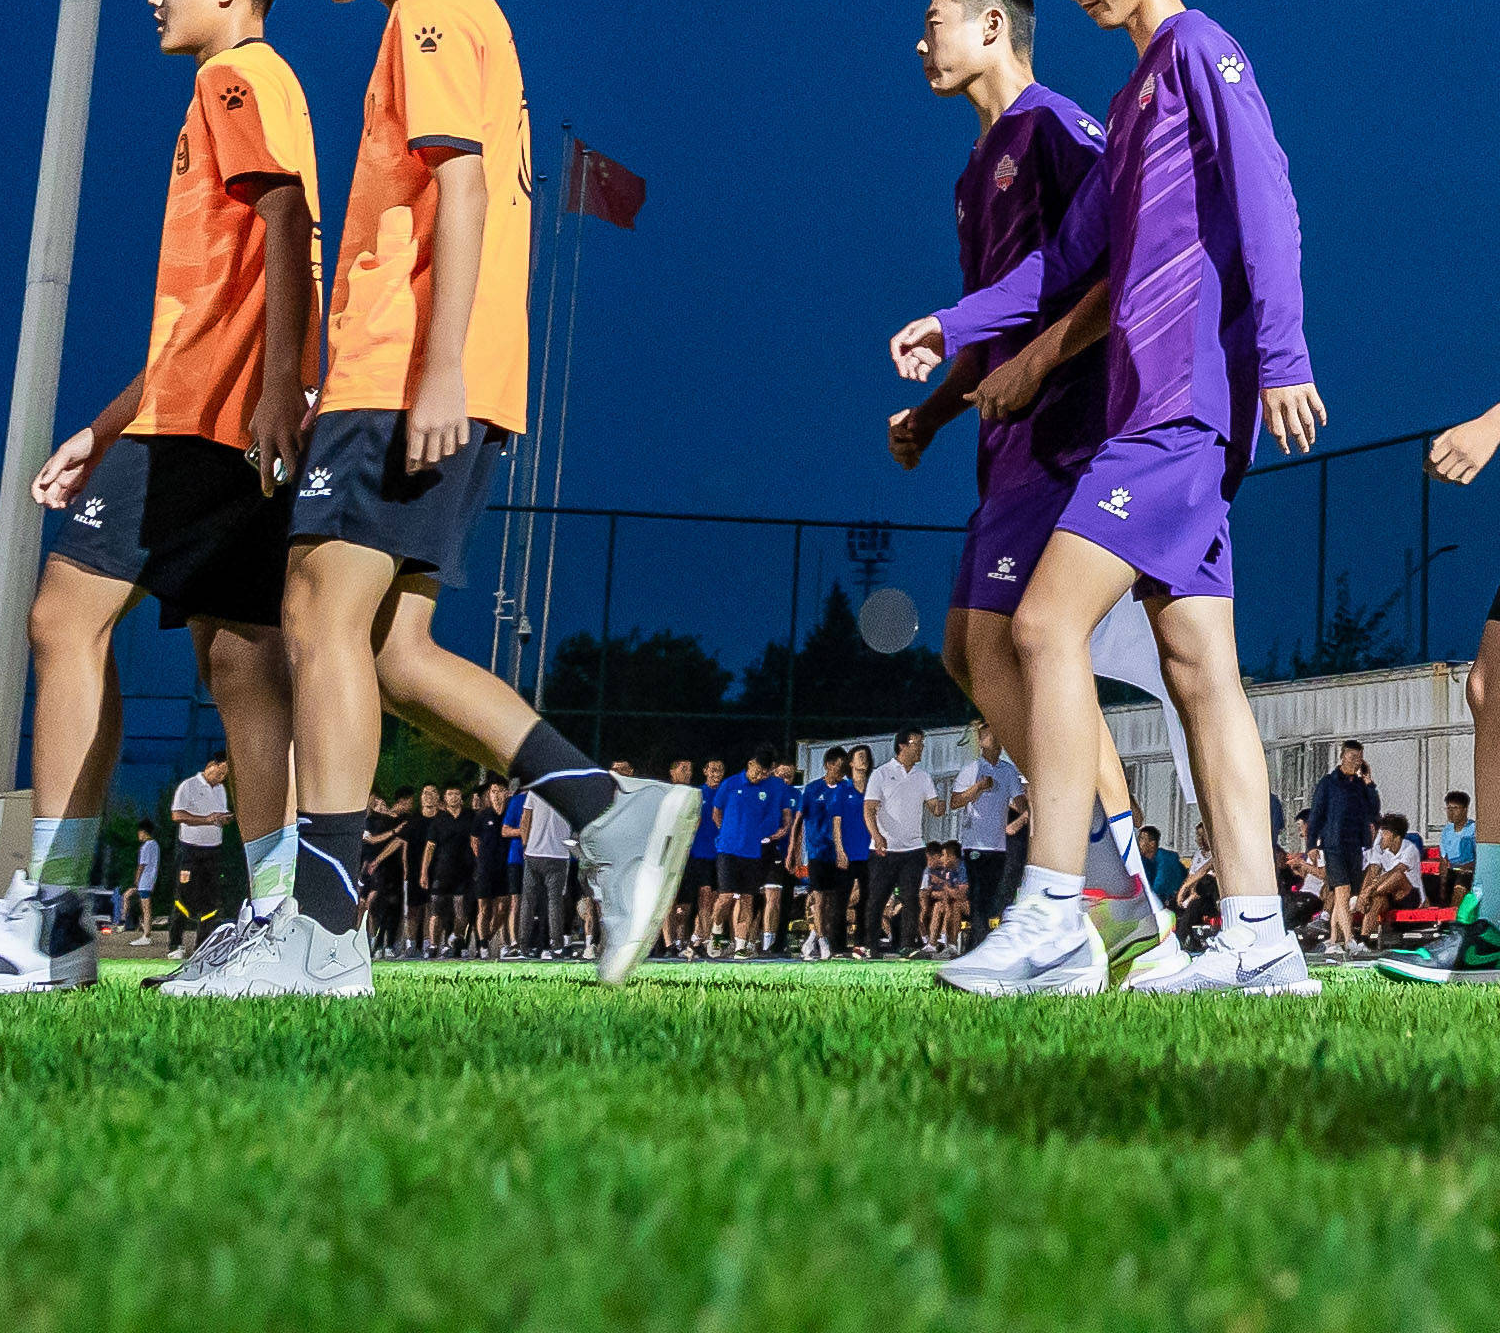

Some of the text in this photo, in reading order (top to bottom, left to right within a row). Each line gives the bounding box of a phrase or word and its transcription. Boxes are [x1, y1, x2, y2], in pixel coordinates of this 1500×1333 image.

[298, 488, 332, 498] KELME
[1097, 500, 1130, 520] KELME
[73, 514, 103, 528] KELME
[987, 571, 1017, 582] KELME
